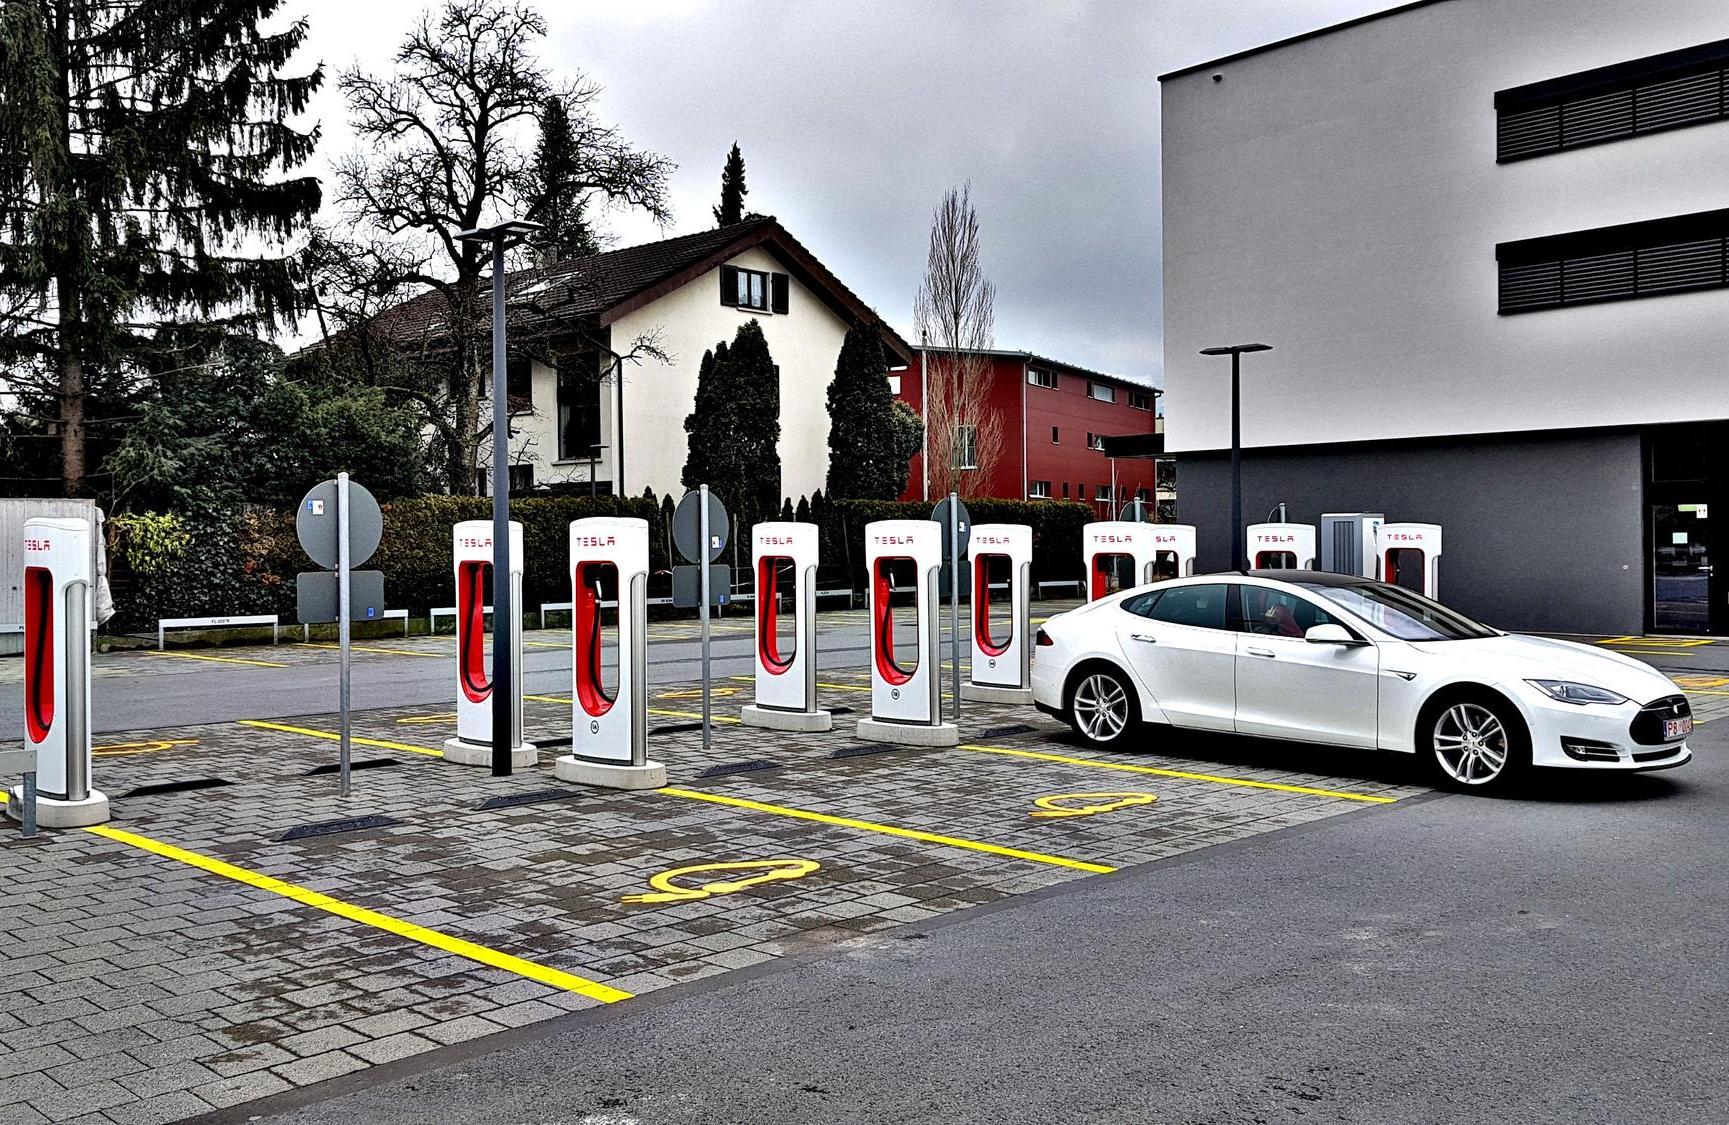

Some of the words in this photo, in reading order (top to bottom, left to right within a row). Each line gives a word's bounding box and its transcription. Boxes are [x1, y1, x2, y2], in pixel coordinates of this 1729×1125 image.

[759, 537, 793, 545] TESLA
[874, 536, 914, 545] TESLA
[976, 536, 1010, 544] TESLA
[1093, 535, 1132, 543] TESLA
[1155, 535, 1176, 543] SLA
[1257, 535, 1294, 543] TESLA
[1387, 533, 1423, 541] TESLA
[25, 539, 50, 551] TESLA
[459, 538, 492, 547] TESLA
[576, 536, 616, 547] TESLA
